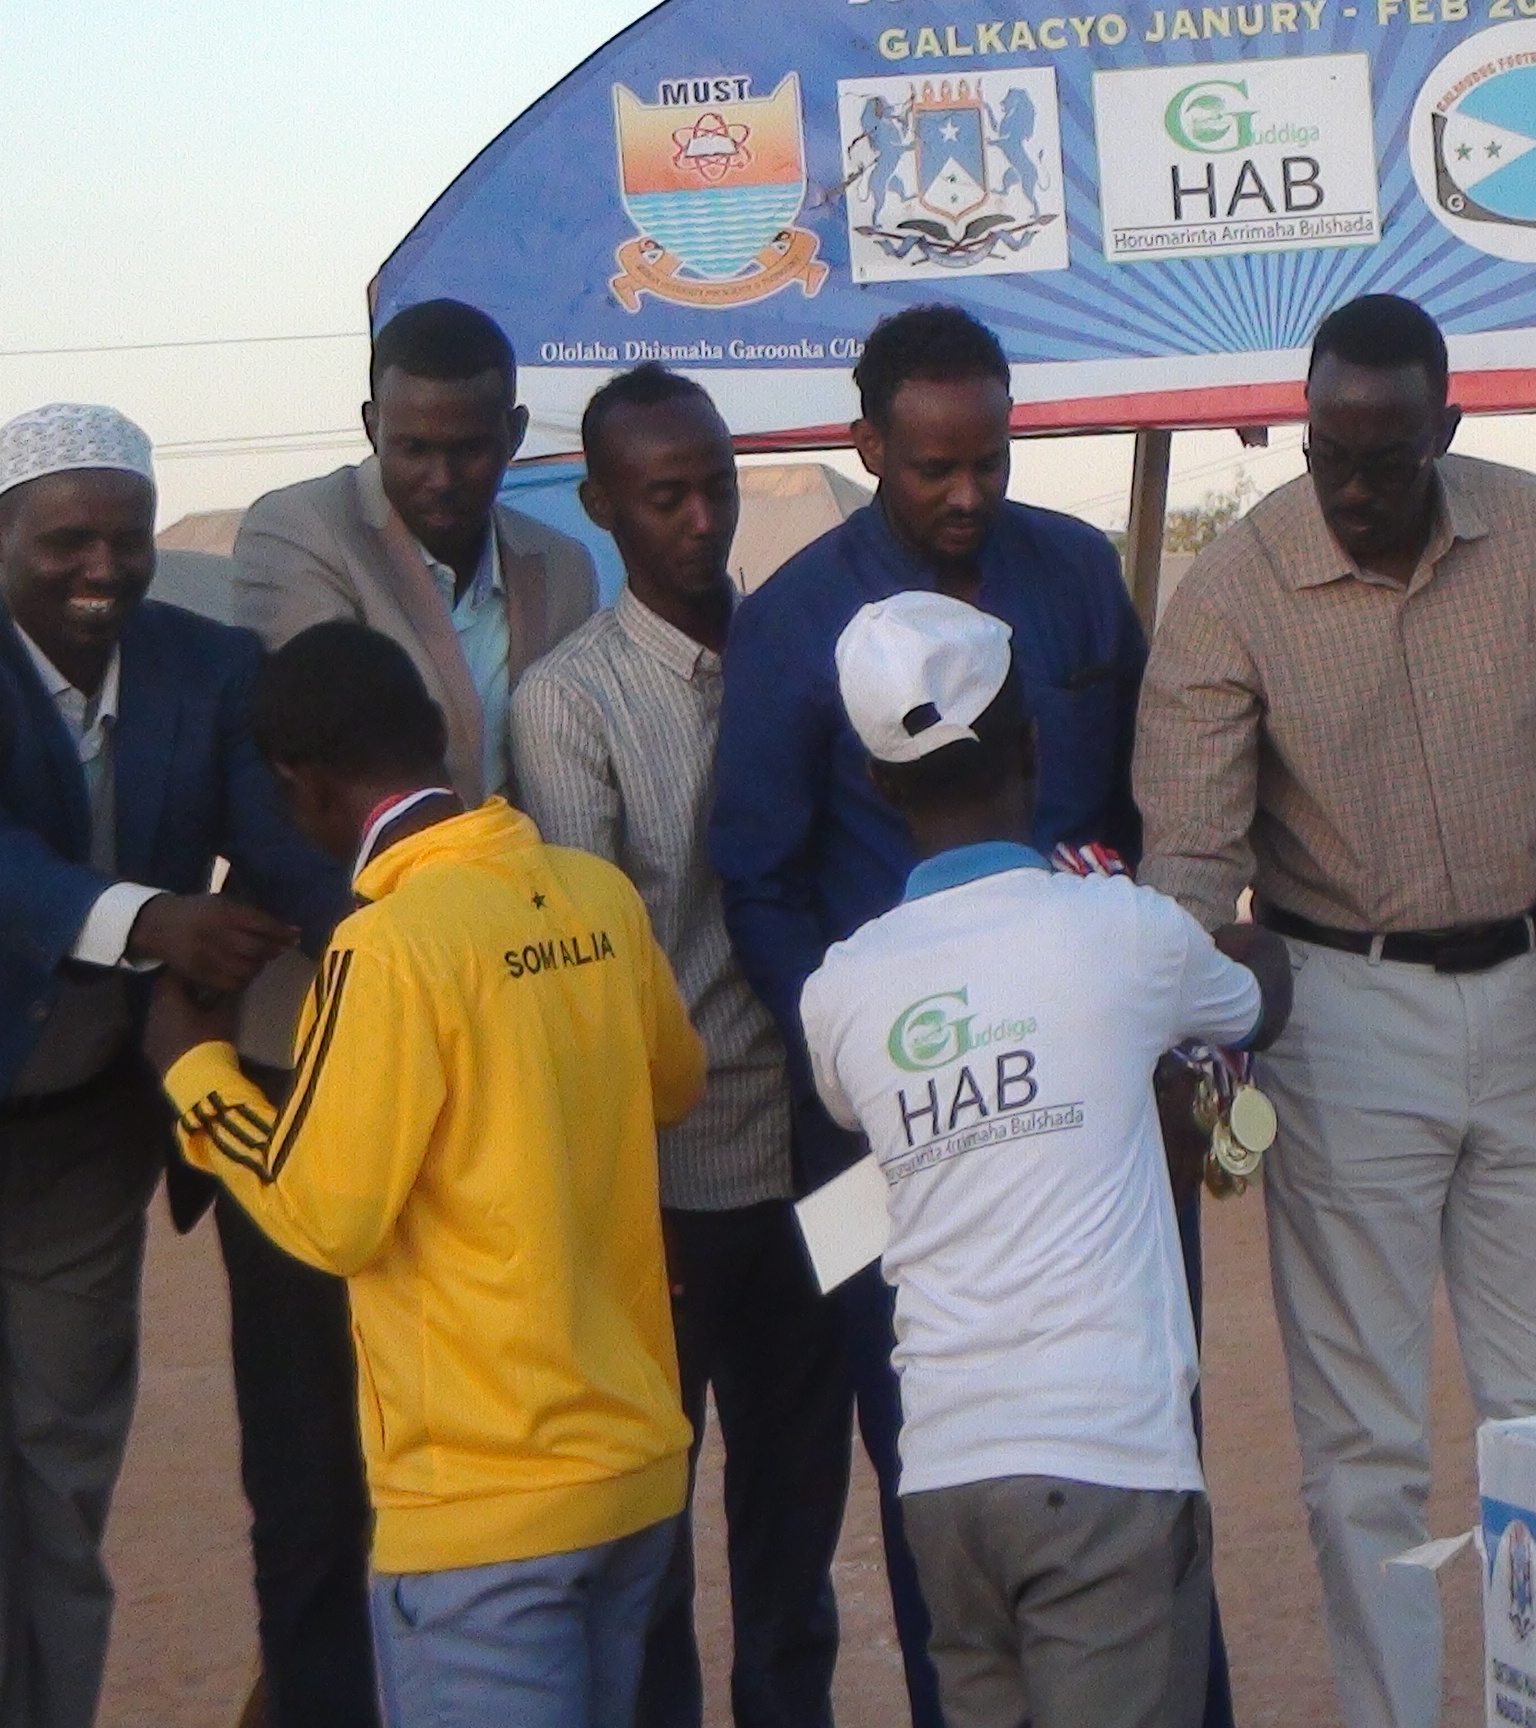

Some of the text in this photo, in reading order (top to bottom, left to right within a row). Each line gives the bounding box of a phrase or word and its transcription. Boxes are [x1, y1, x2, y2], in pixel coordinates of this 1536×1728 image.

[878, 13, 1128, 60] GALKACYO
[1145, 0, 1325, 42] JANURY
[1375, 0, 1470, 26] FEB
[662, 79, 748, 105] MUST
[1171, 156, 1325, 221] HAB
[1114, 228, 1217, 249] Horumarinta
[1222, 221, 1295, 241] Arrimaha
[541, 341, 618, 362] Ololaha
[625, 340, 722, 361] Dhismaha
[728, 338, 825, 360] Garoonka
[504, 930, 616, 979] SOMALIA
[898, 1050, 1039, 1147] HAB
[1011, 1105, 1085, 1136] Bulshada
